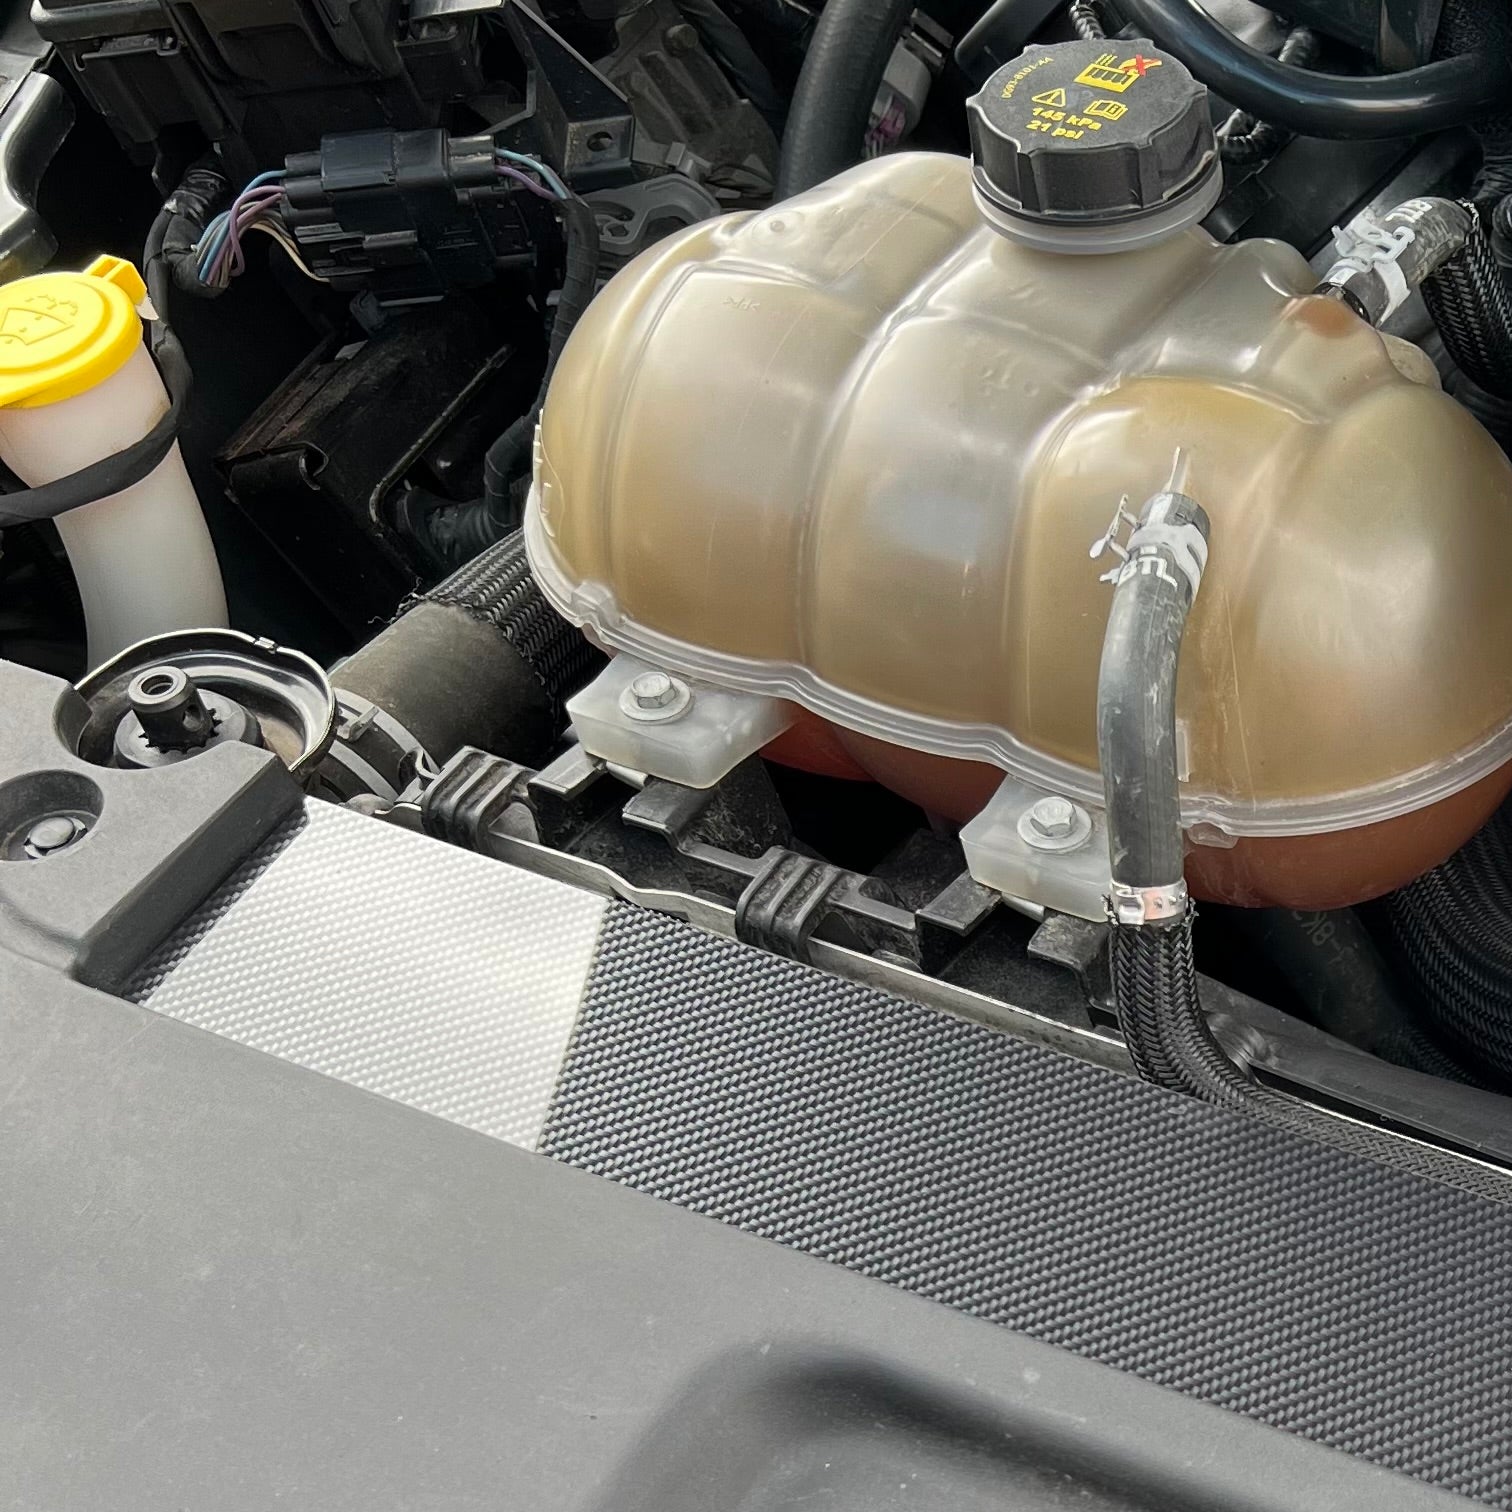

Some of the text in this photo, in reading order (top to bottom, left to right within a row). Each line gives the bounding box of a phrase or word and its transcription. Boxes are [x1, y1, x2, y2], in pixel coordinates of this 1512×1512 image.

[1032, 107, 1102, 130] 145 kPa
[1026, 120, 1084, 140] 21 psi
